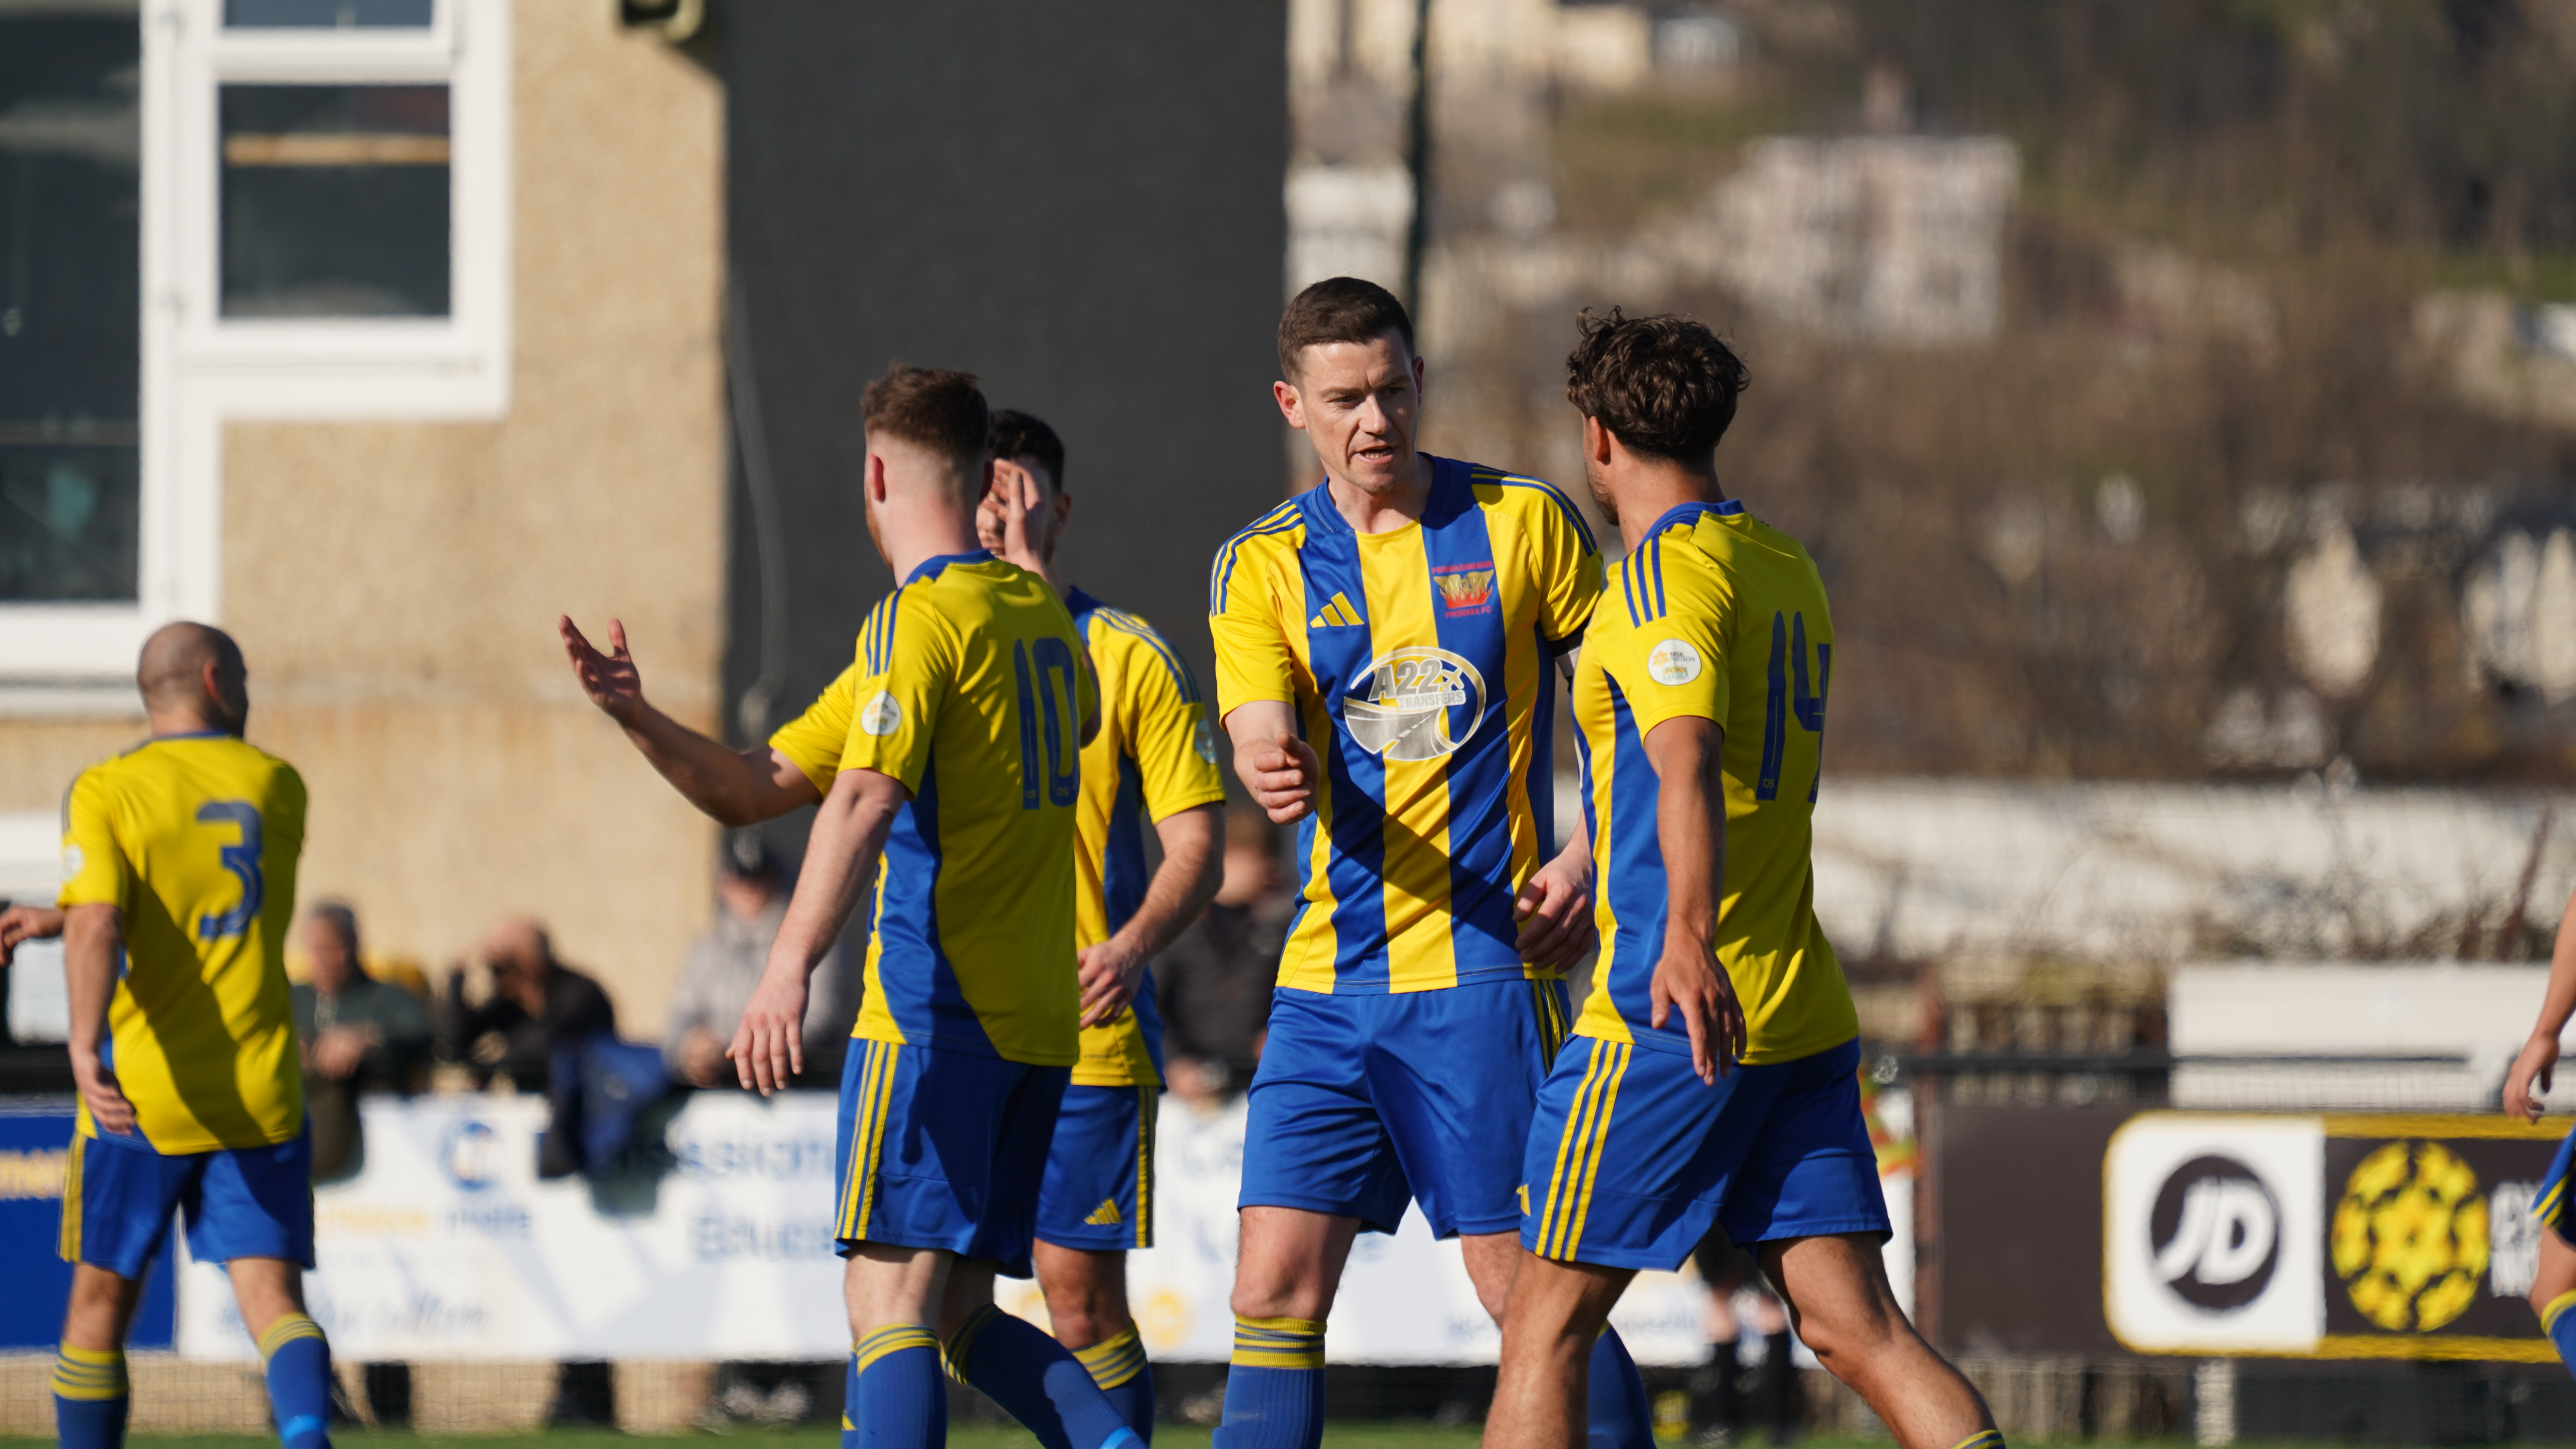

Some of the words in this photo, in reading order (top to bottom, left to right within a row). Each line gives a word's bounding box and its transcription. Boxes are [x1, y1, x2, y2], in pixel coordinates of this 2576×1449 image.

[1445, 607, 1479, 618] PHOENIX
[1014, 637, 1080, 810] 10
[1368, 658, 1443, 702] A22
[1397, 690, 1466, 710] TRANSFERS
[1756, 610, 1831, 803] 14
[195, 800, 264, 941] 3
[2155, 1176, 2276, 1285] JD
